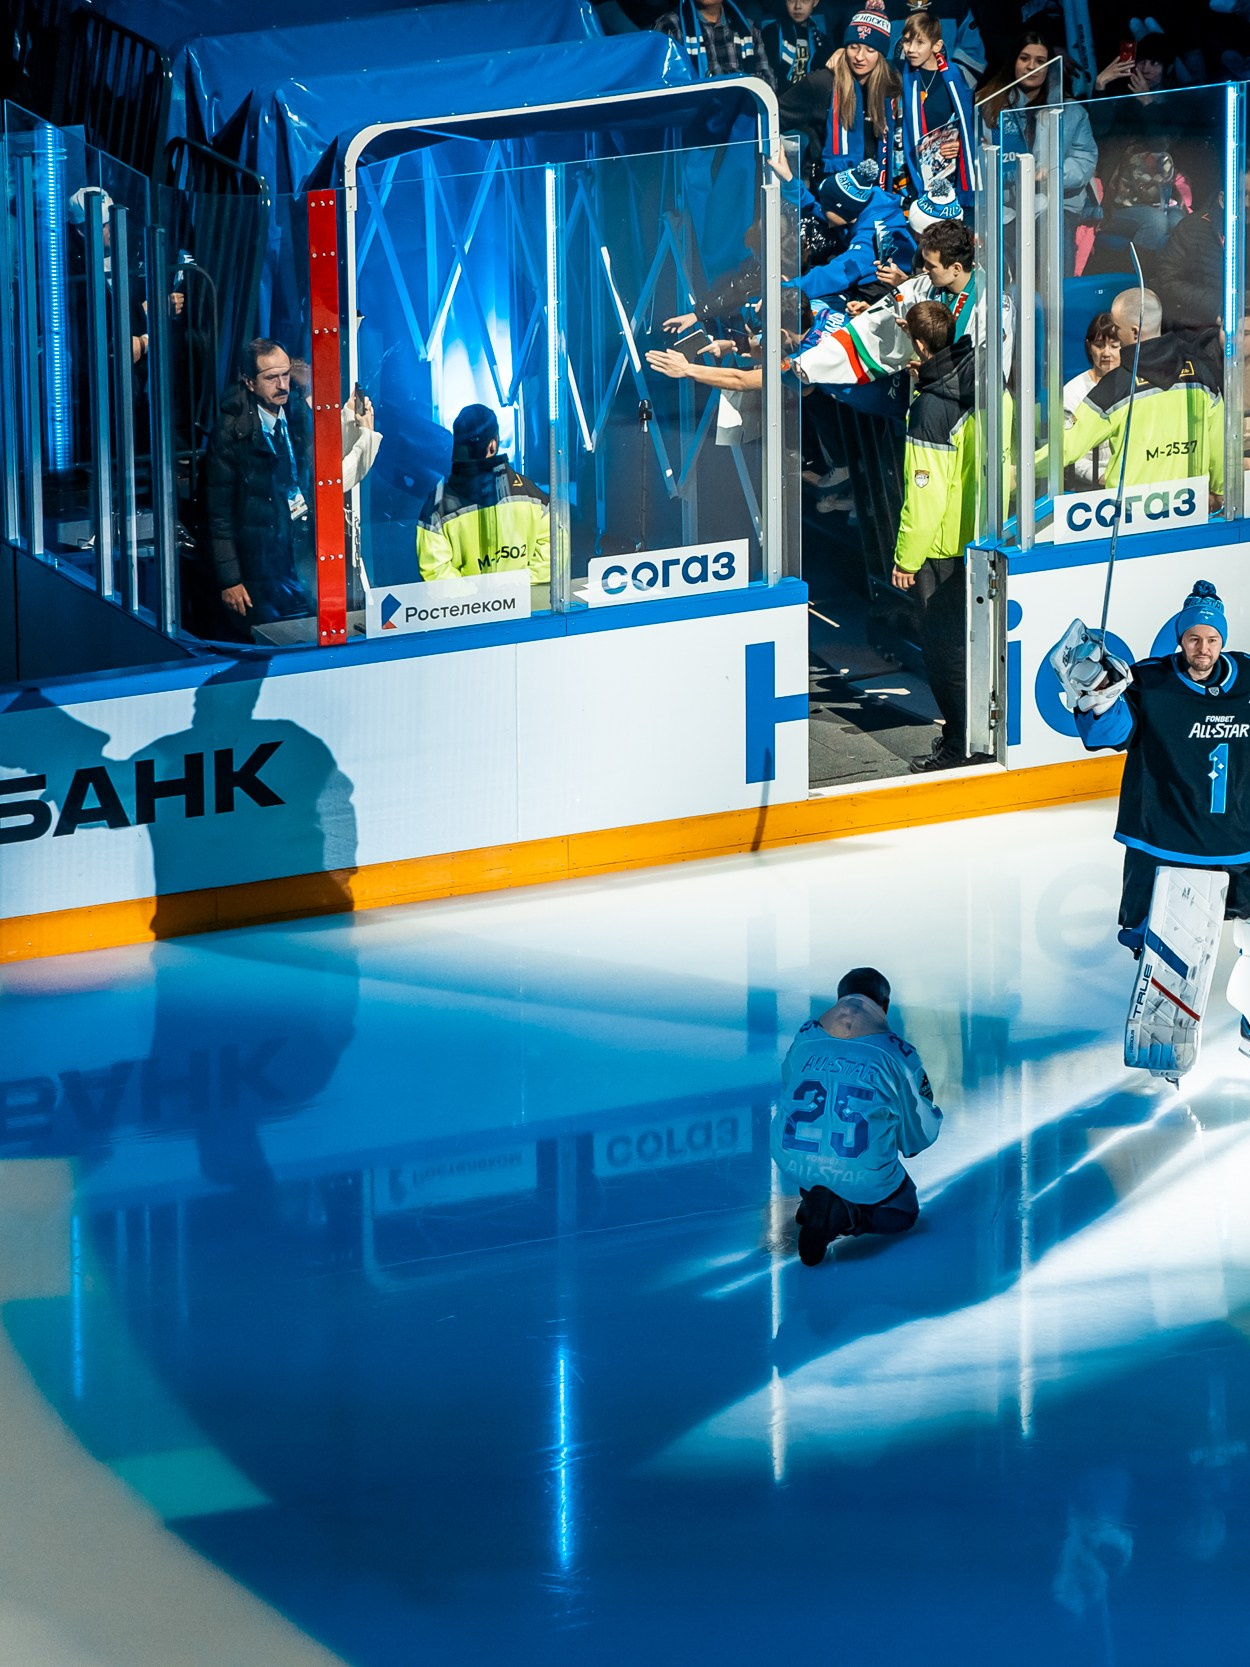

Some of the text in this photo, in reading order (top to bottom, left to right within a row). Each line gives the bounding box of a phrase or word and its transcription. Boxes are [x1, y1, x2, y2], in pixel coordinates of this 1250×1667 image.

[1066, 488, 1196, 532] согаз
[601, 551, 736, 595] согаз
[405, 597, 516, 623] Ростелеком
[1205, 715, 1235, 723] FONBET
[0, 741, 286, 845] БАНК
[1208, 743, 1229, 814] 1
[1132, 963, 1153, 1019] TRUE
[782, 1079, 876, 1159] 25
